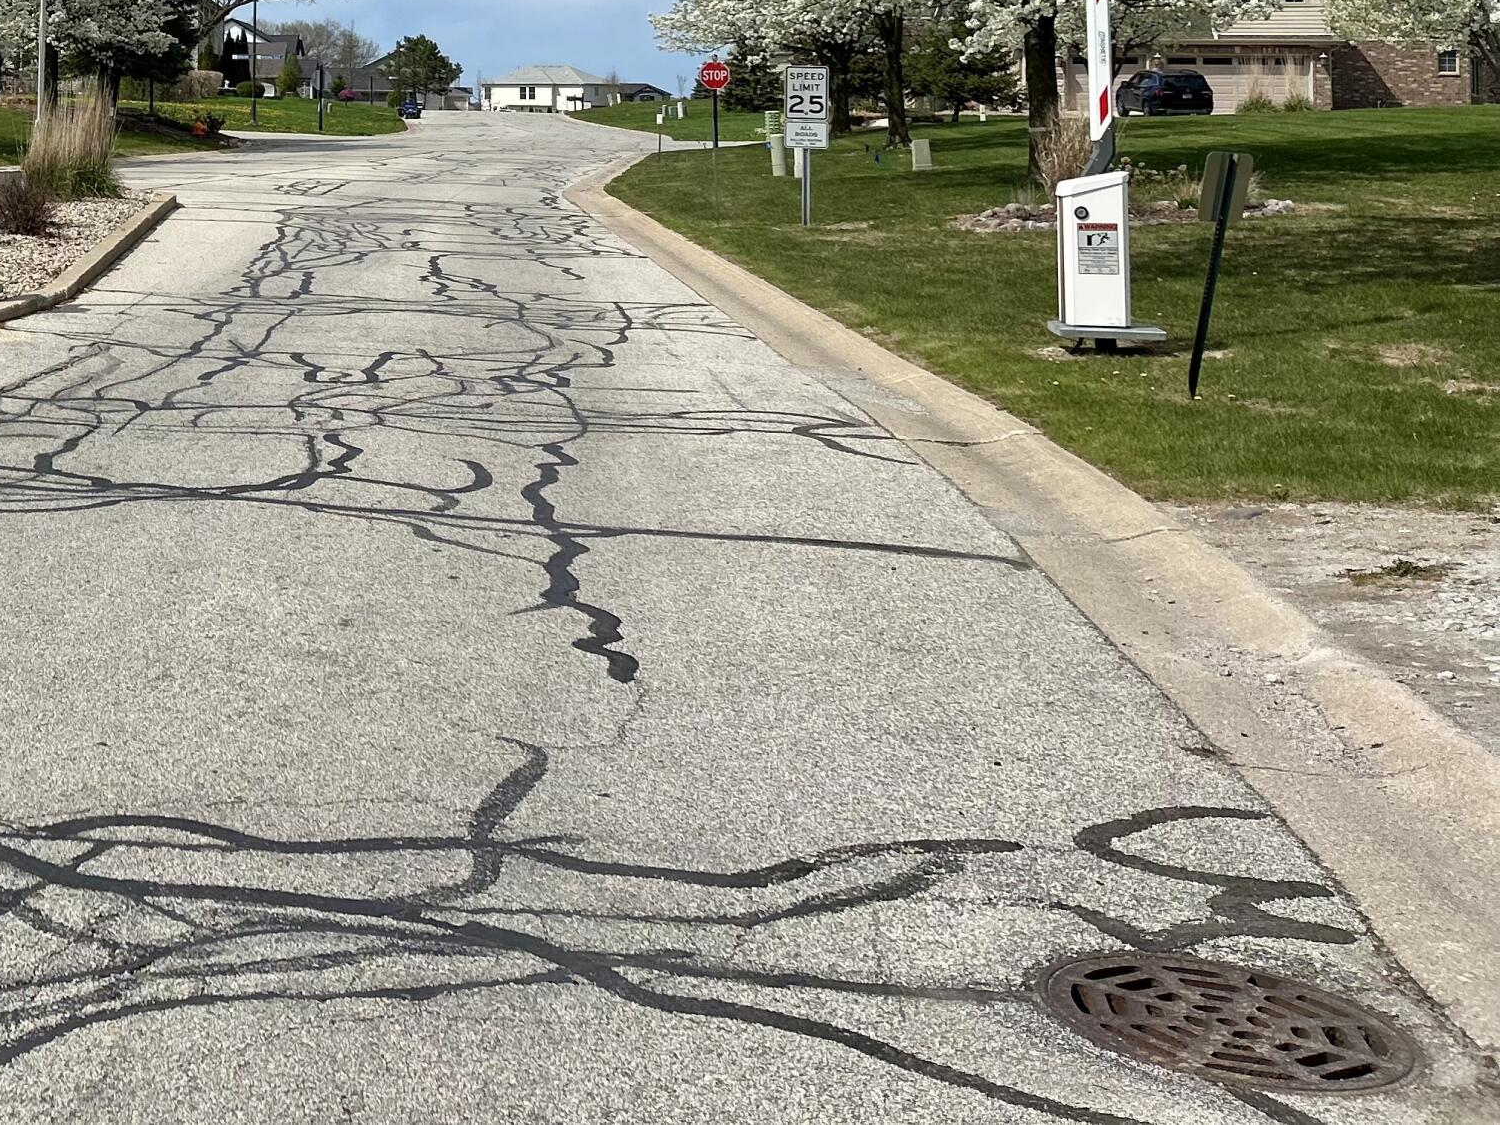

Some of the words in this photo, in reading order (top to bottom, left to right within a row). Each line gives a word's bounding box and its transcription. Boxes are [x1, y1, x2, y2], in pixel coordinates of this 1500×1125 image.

[702, 70, 728, 81] STOP
[789, 72, 825, 81] SPEED
[792, 83, 821, 92] LIMIT
[789, 94, 824, 114] 25
[1083, 223, 1116, 231] WARNING
